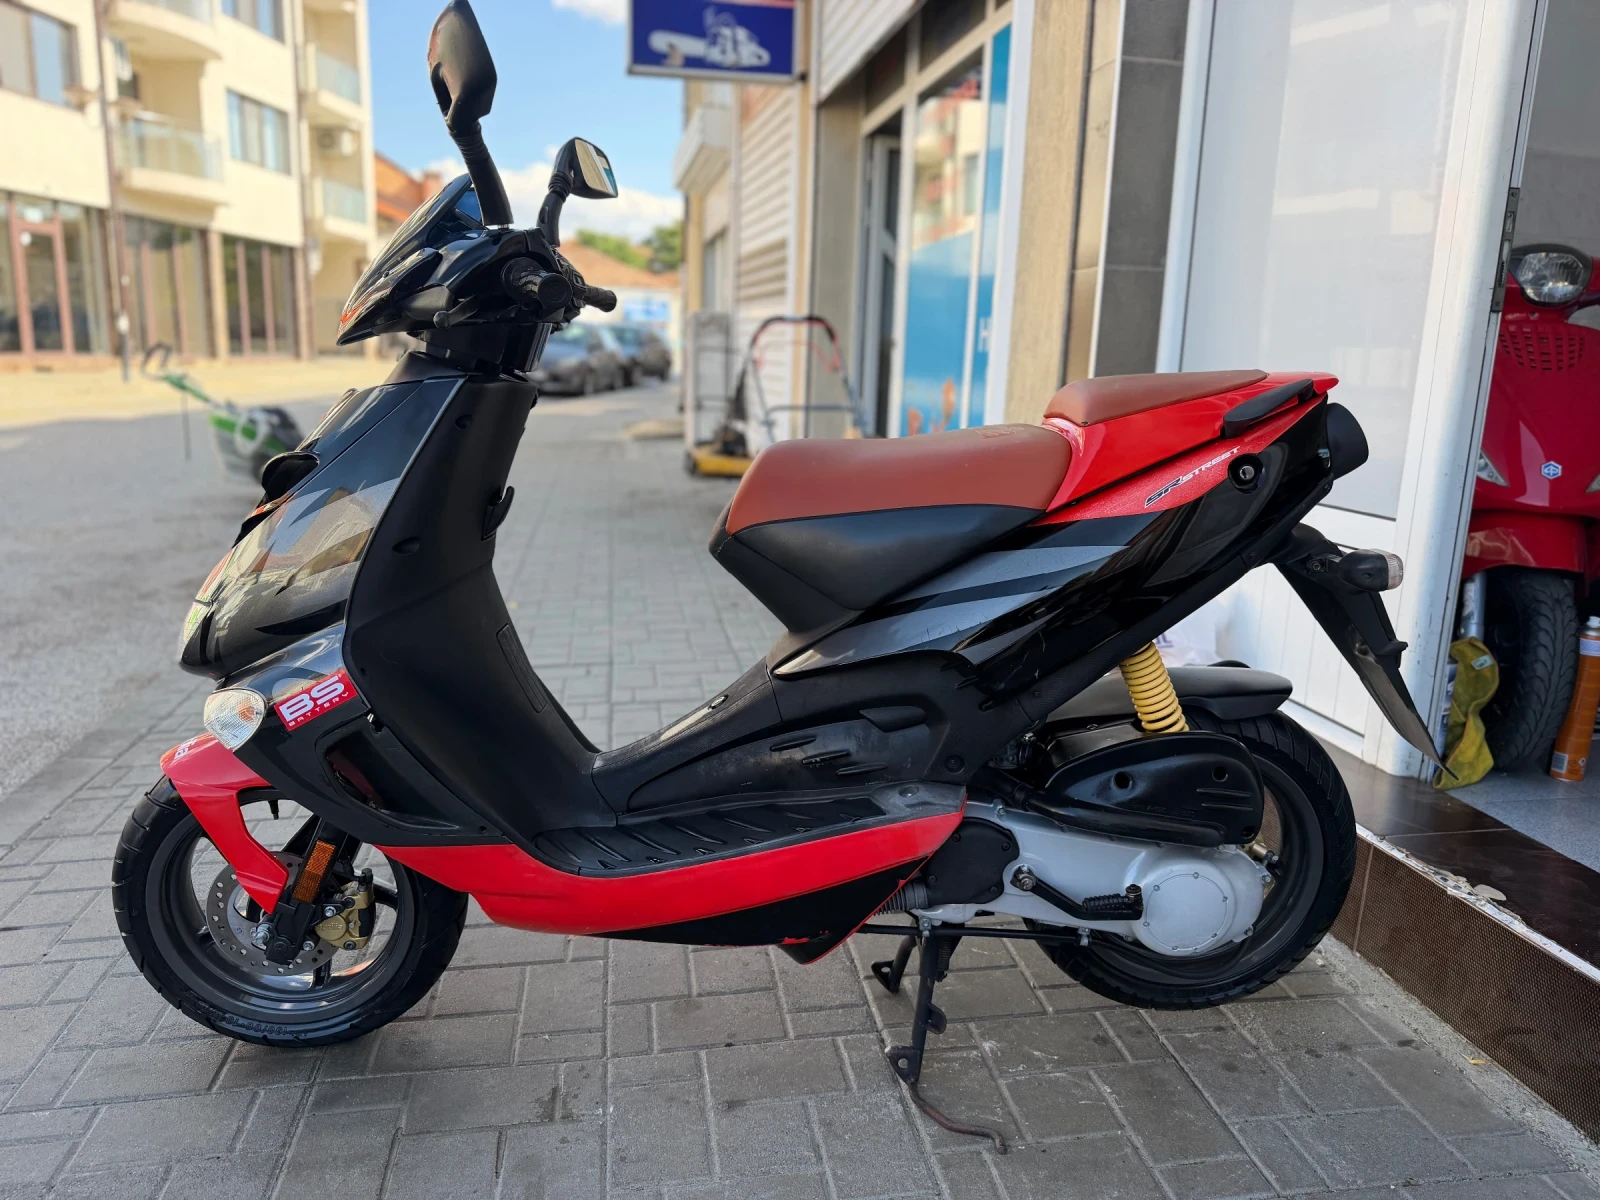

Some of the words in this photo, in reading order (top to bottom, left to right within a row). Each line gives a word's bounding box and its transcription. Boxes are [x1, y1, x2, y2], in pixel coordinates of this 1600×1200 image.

[1180, 445, 1240, 483] STREET
[279, 675, 345, 722] BS
[288, 691, 349, 727] BATTERY
